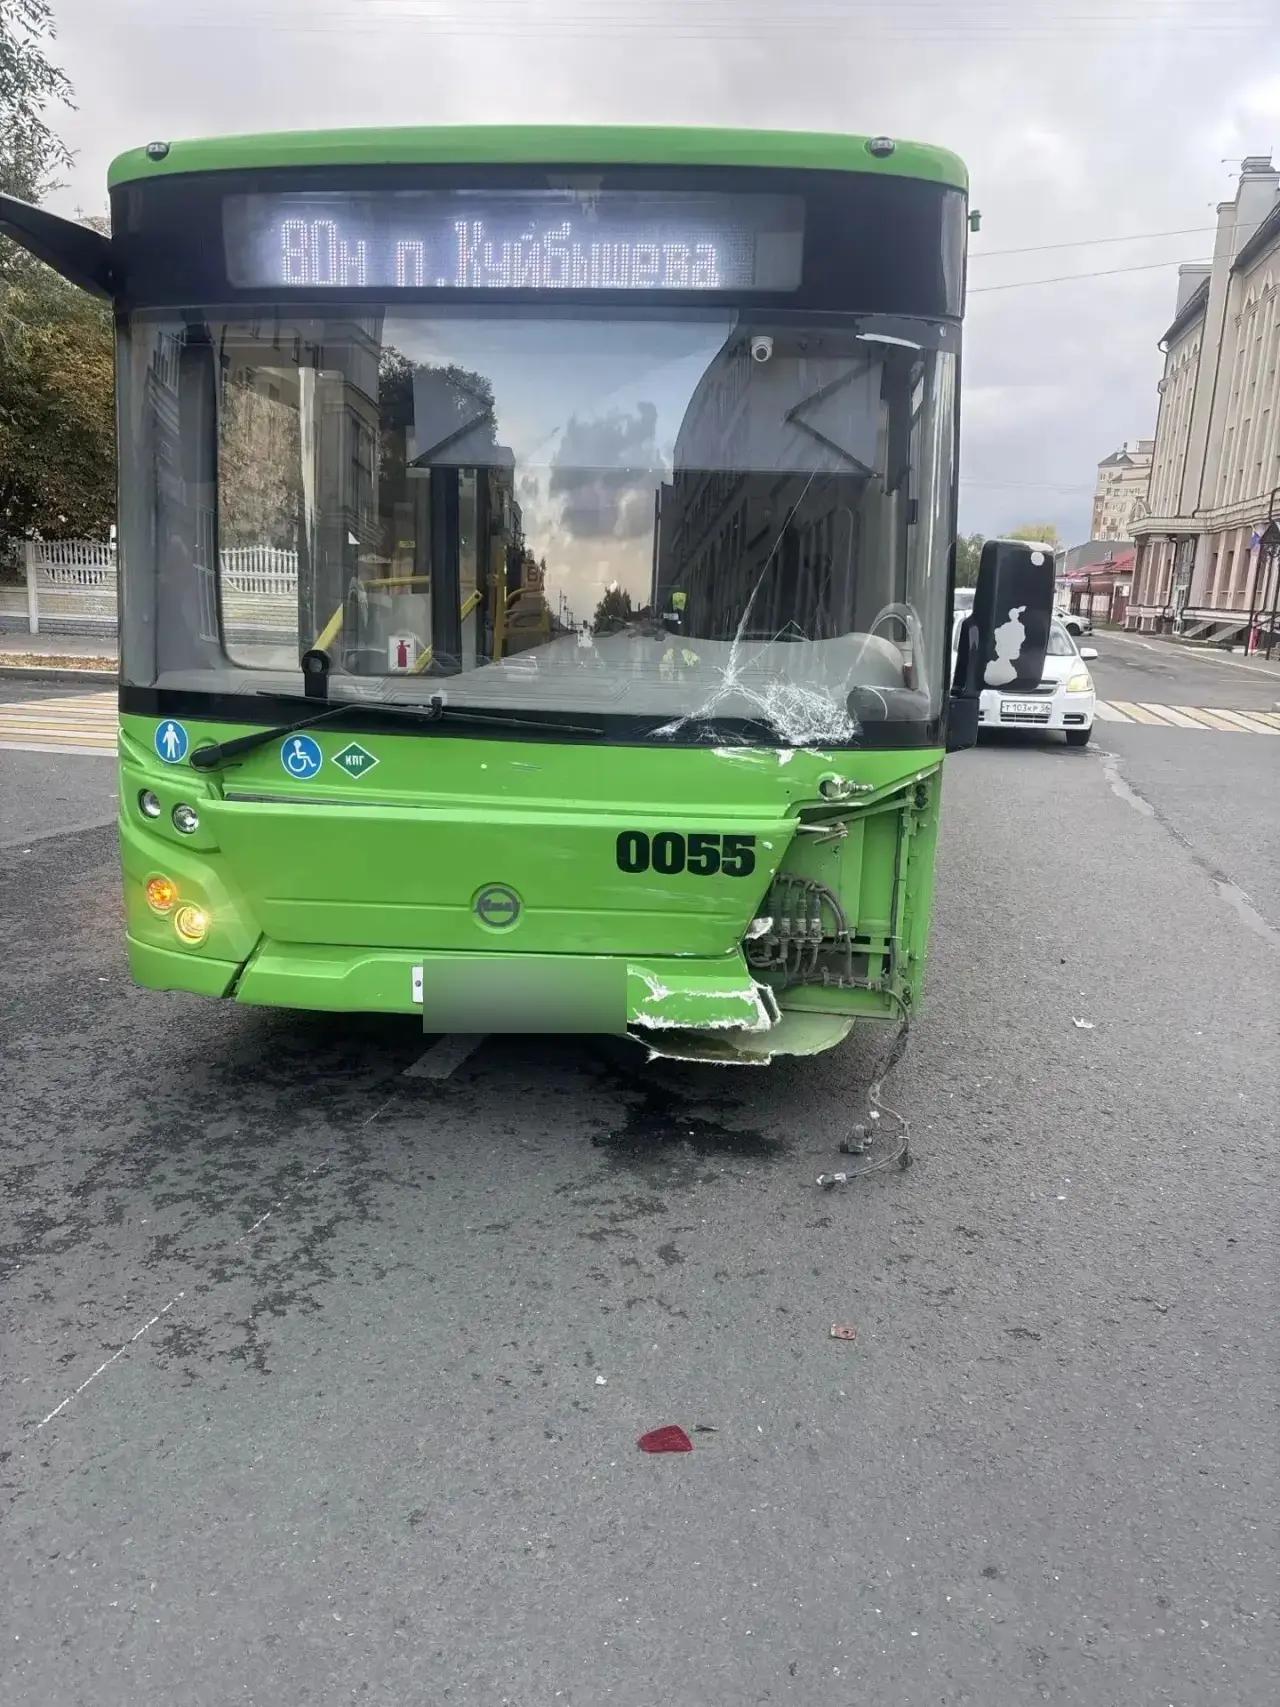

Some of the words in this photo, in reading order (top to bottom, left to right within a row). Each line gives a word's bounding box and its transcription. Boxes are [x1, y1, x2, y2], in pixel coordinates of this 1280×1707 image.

[281, 219, 366, 286] 80н
[345, 754, 365, 766] КПГ
[616, 830, 756, 878] 0055
